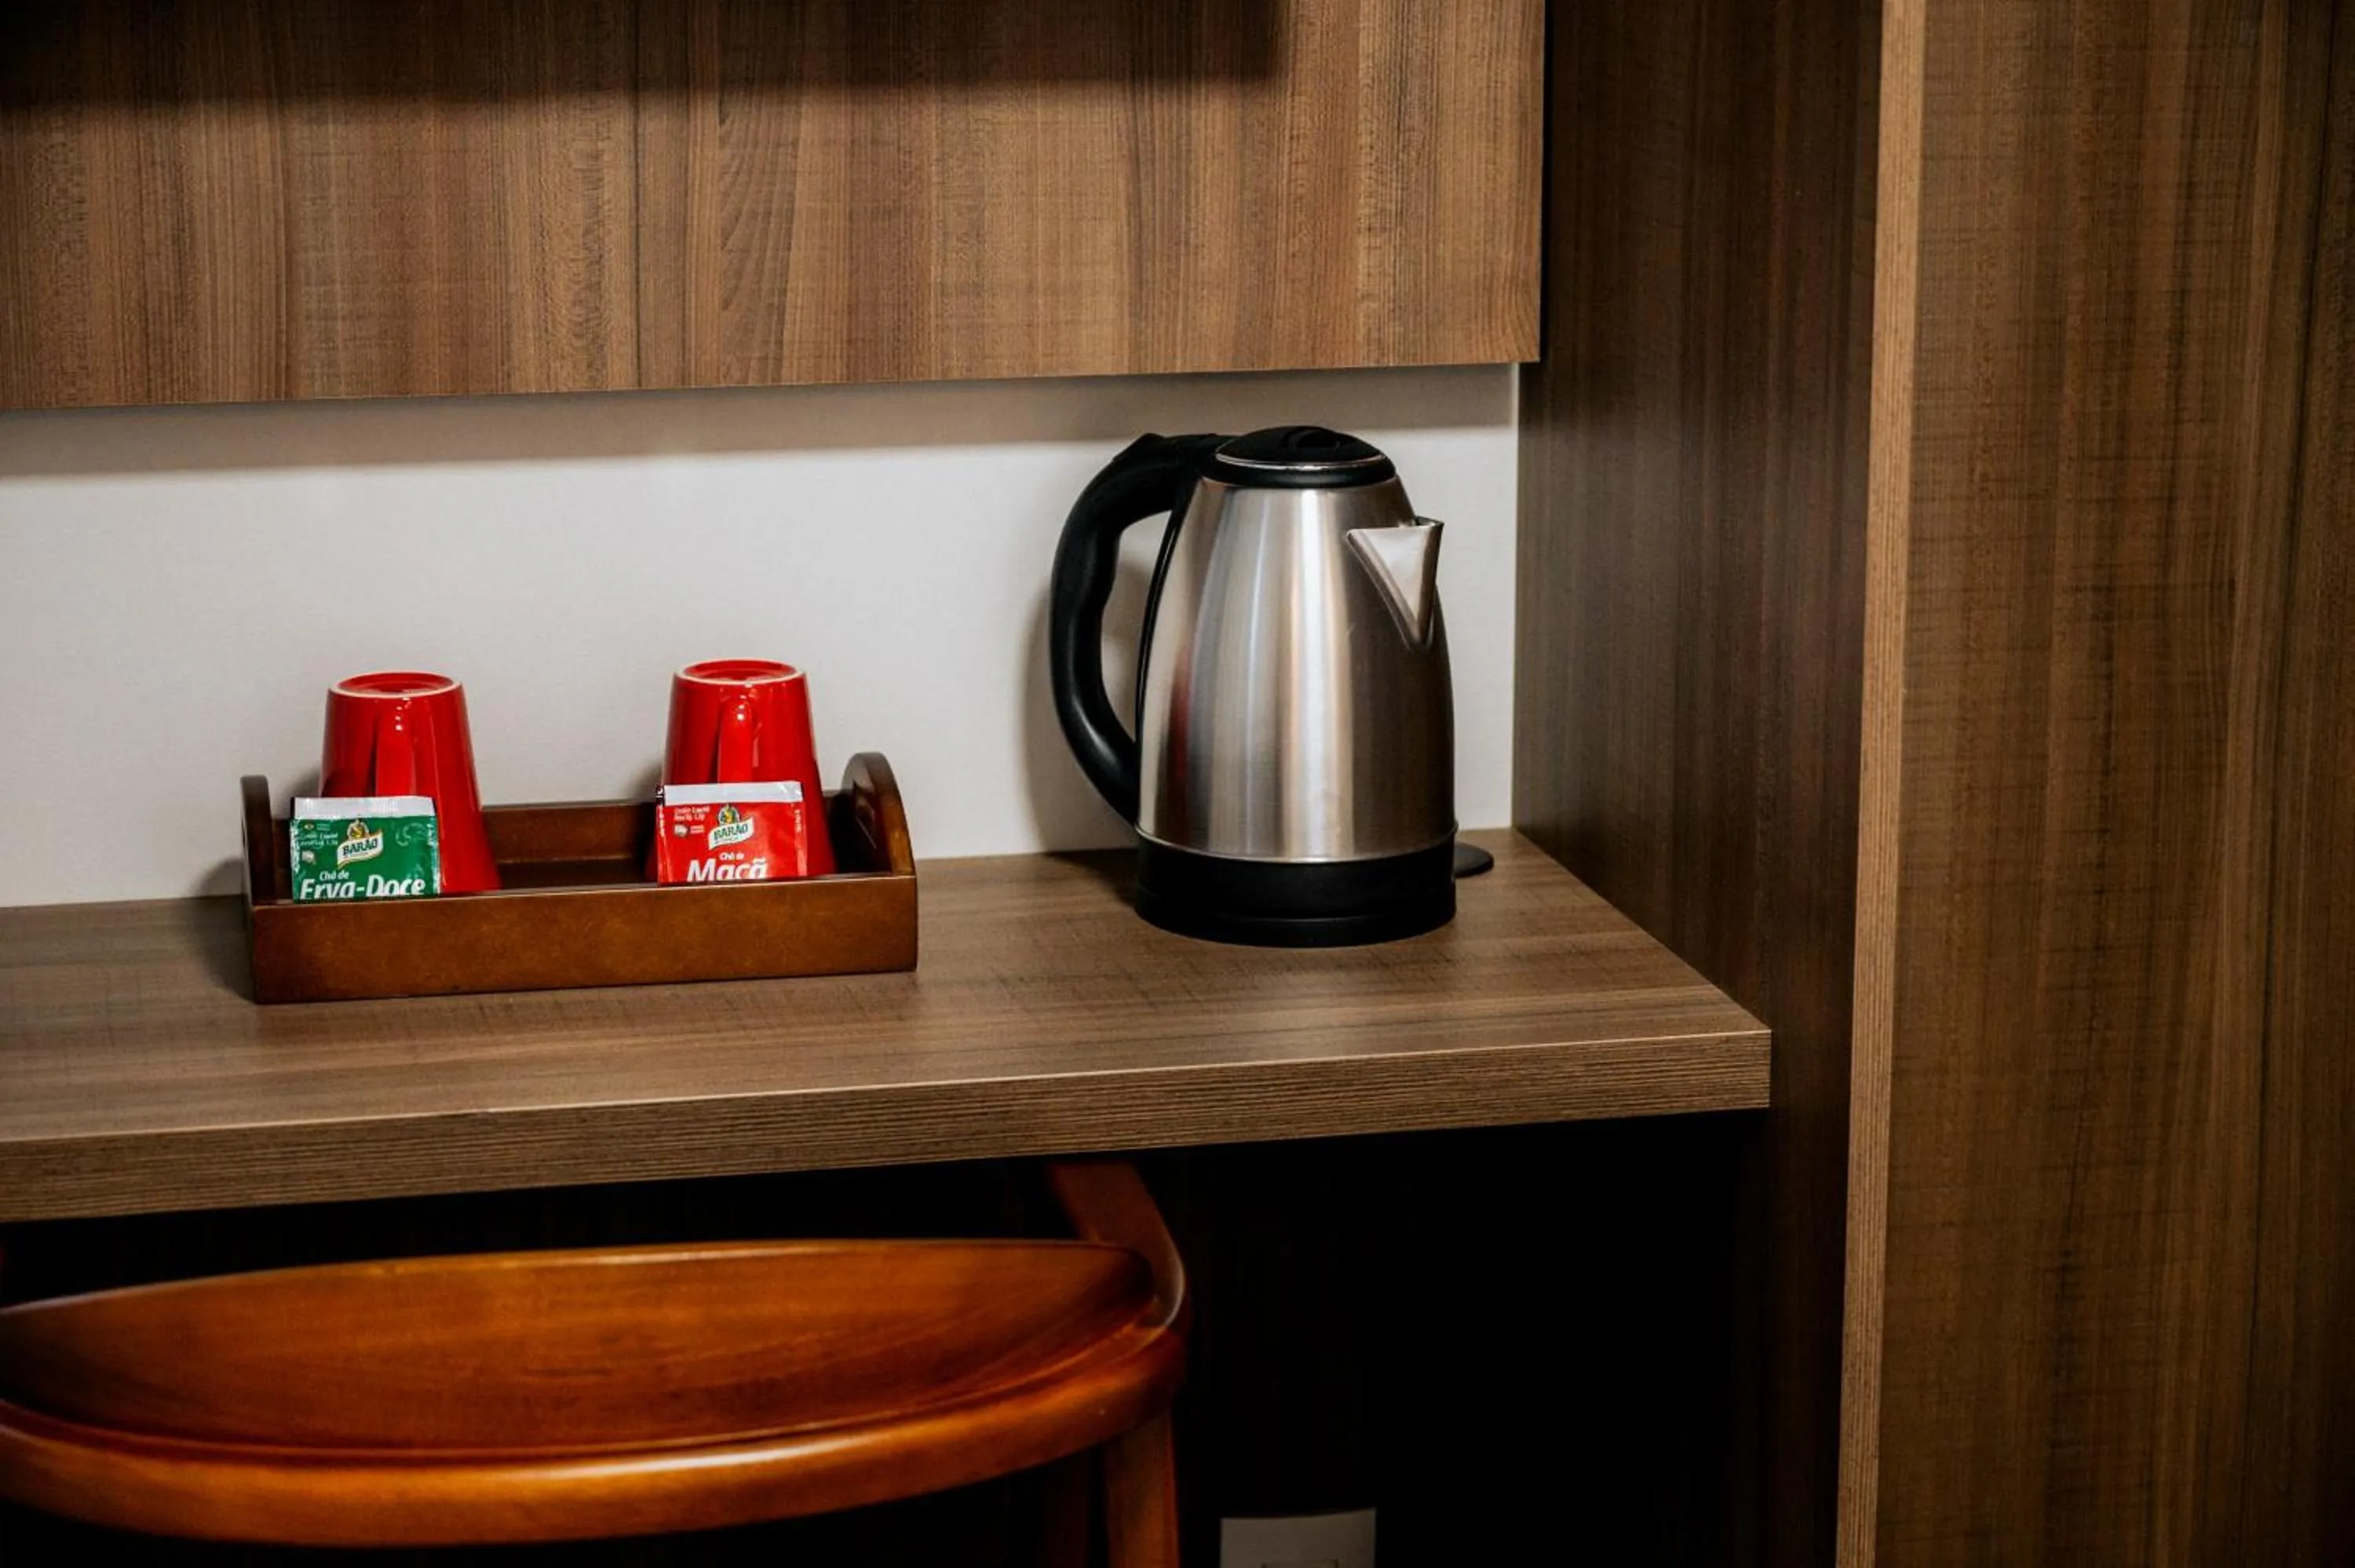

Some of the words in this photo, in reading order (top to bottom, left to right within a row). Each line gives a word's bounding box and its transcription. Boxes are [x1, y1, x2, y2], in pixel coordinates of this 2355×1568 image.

[319, 870, 336, 881] Chá
[337, 870, 349, 881] de
[299, 873, 427, 900] Erva-Doce
